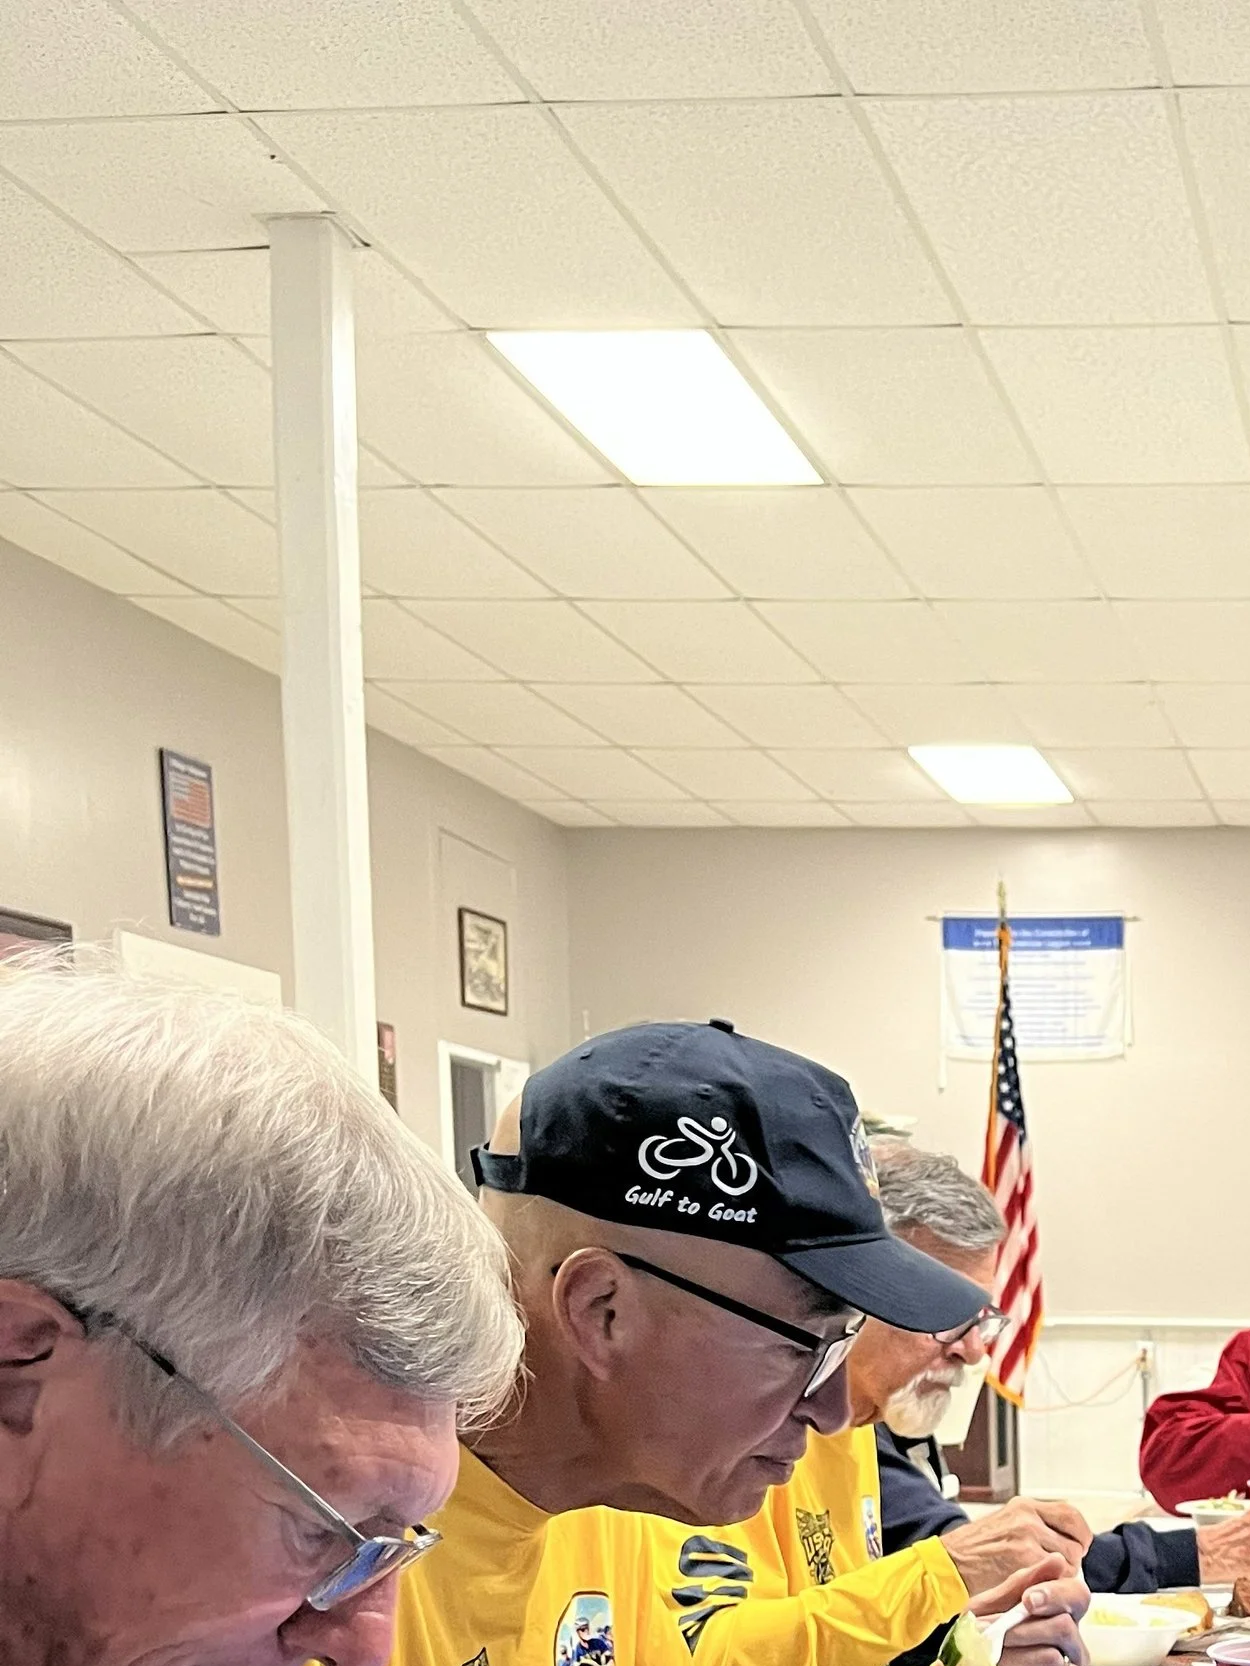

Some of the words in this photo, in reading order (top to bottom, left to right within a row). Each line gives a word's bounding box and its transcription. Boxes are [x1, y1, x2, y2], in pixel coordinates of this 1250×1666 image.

[625, 1185, 674, 1207] Gulf
[677, 1197, 700, 1215] to
[708, 1202, 758, 1224] Goat
